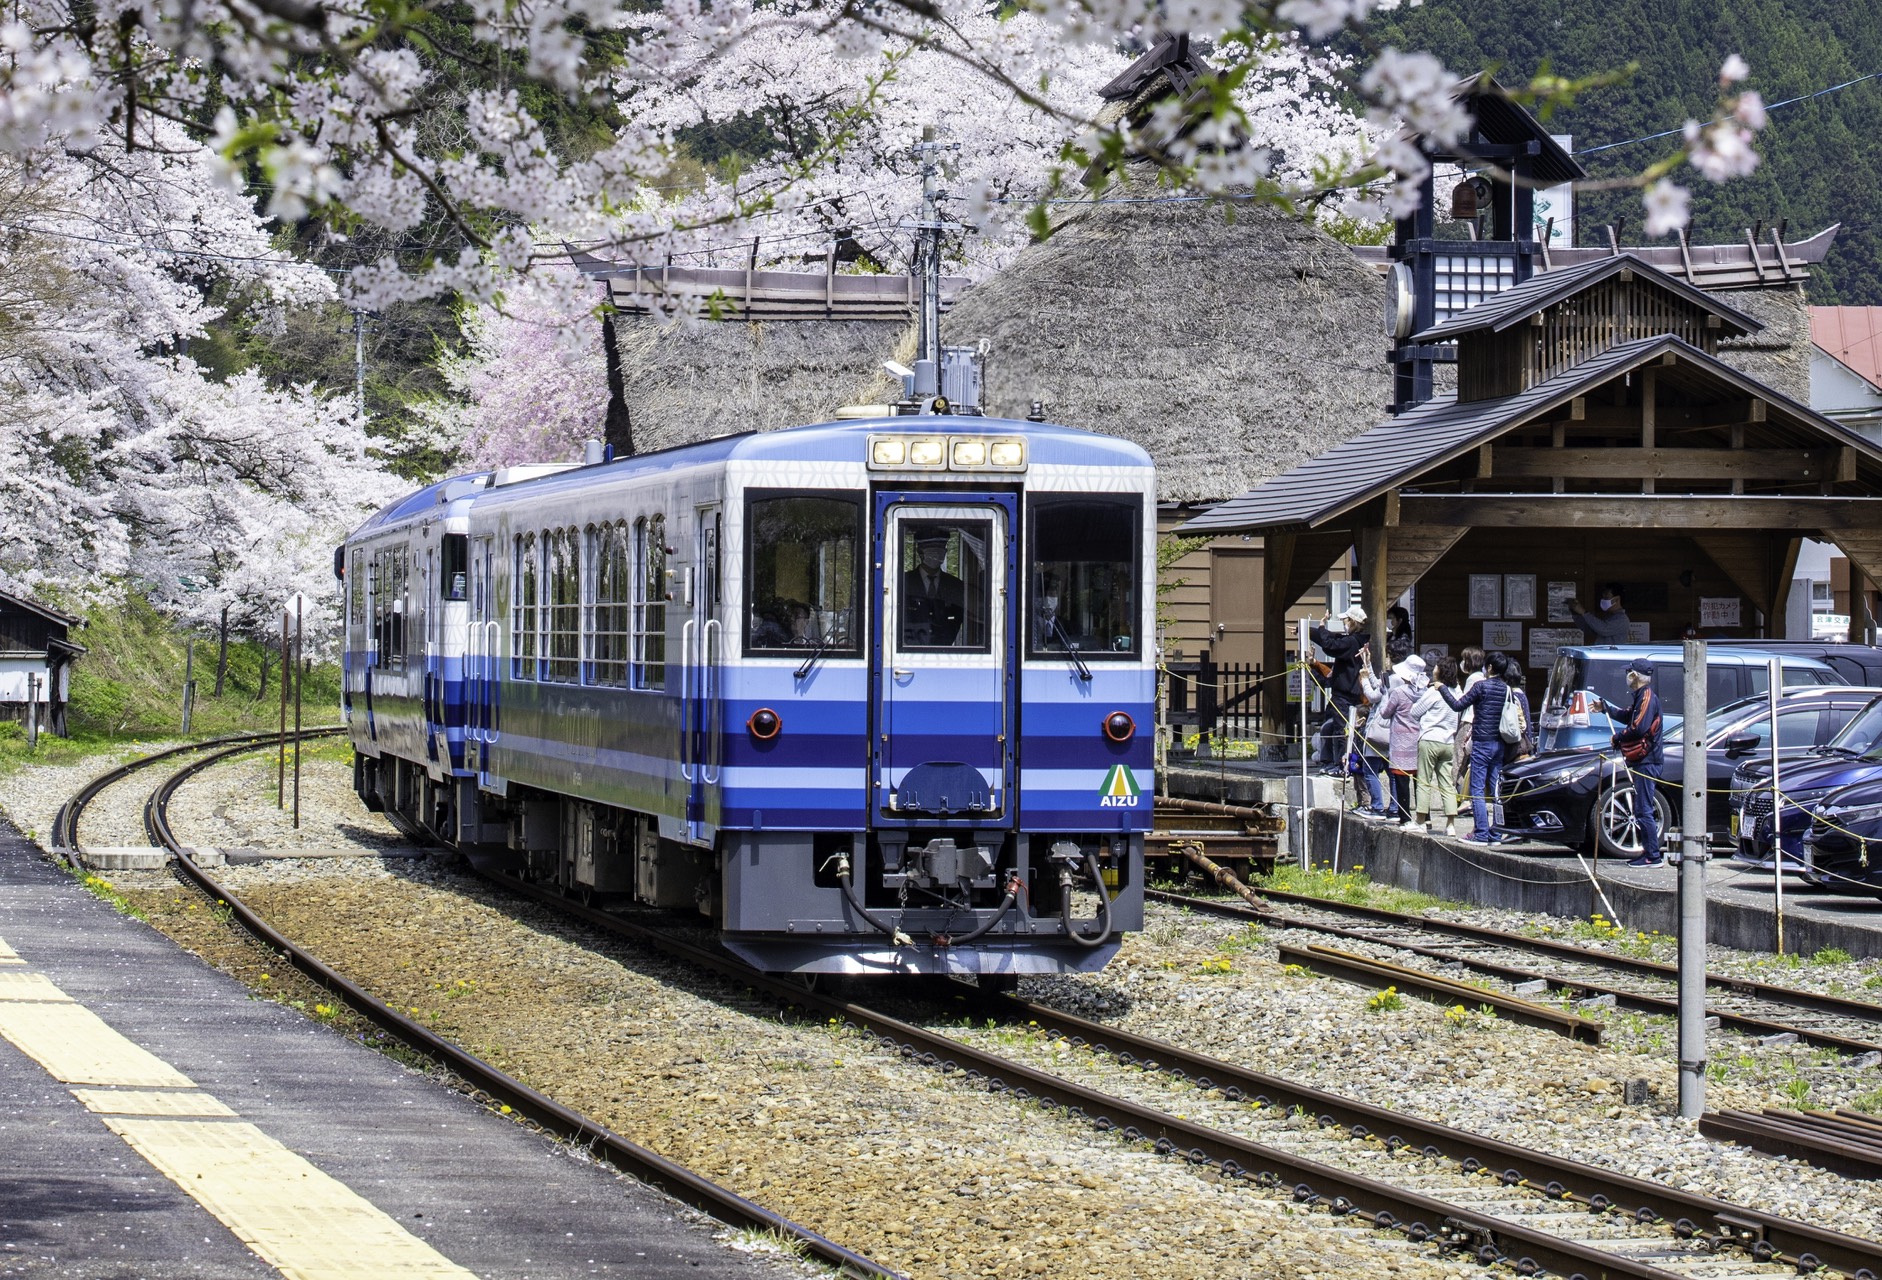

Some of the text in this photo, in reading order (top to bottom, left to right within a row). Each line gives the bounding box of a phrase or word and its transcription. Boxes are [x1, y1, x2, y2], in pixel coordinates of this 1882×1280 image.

[1702, 602, 1738, 610] 防犯カメラ
[1100, 796, 1138, 807] AIZU
